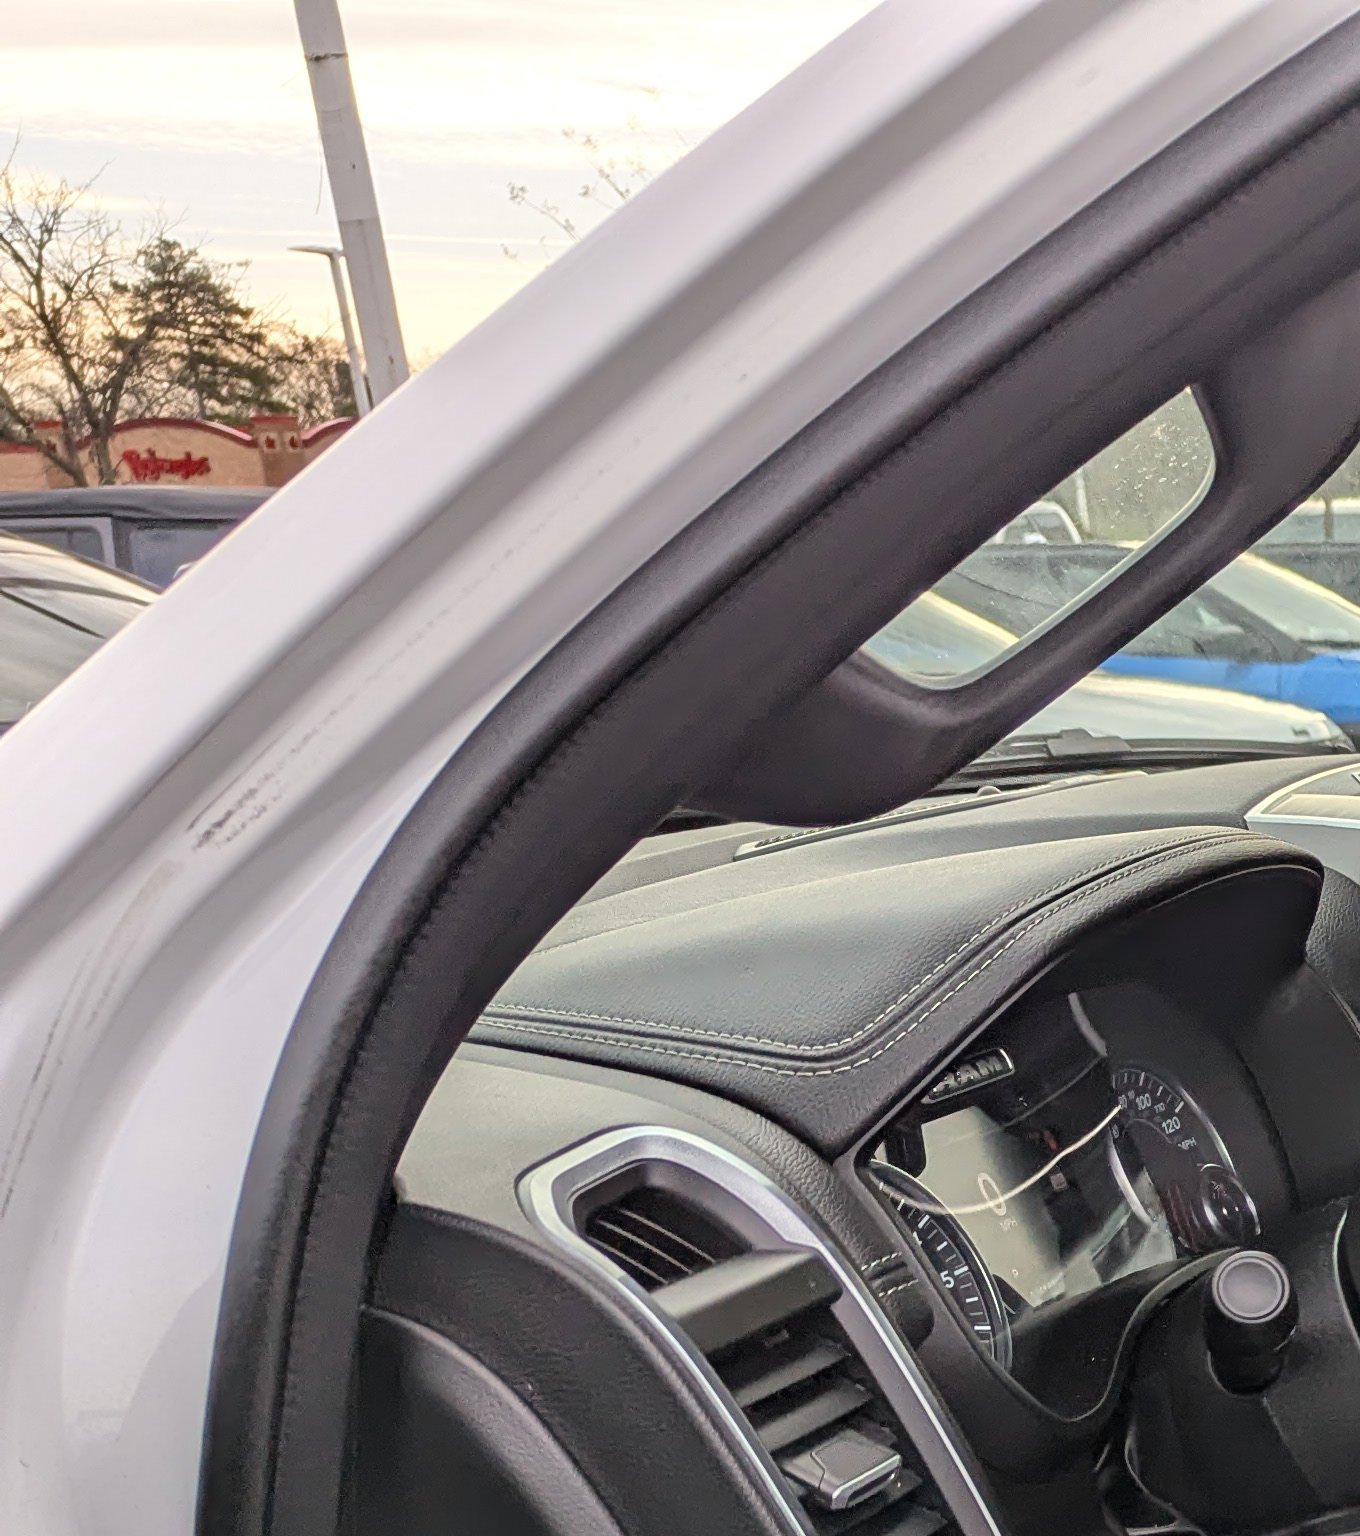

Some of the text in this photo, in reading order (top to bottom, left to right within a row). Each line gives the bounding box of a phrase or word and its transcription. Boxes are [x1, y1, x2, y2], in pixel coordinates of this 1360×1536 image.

[930, 1056, 1003, 1095] RAM
[1136, 1093, 1151, 1110] 100
[1154, 1102, 1165, 1113] 110
[1161, 1116, 1180, 1134] 120
[940, 1271, 955, 1289] 5
